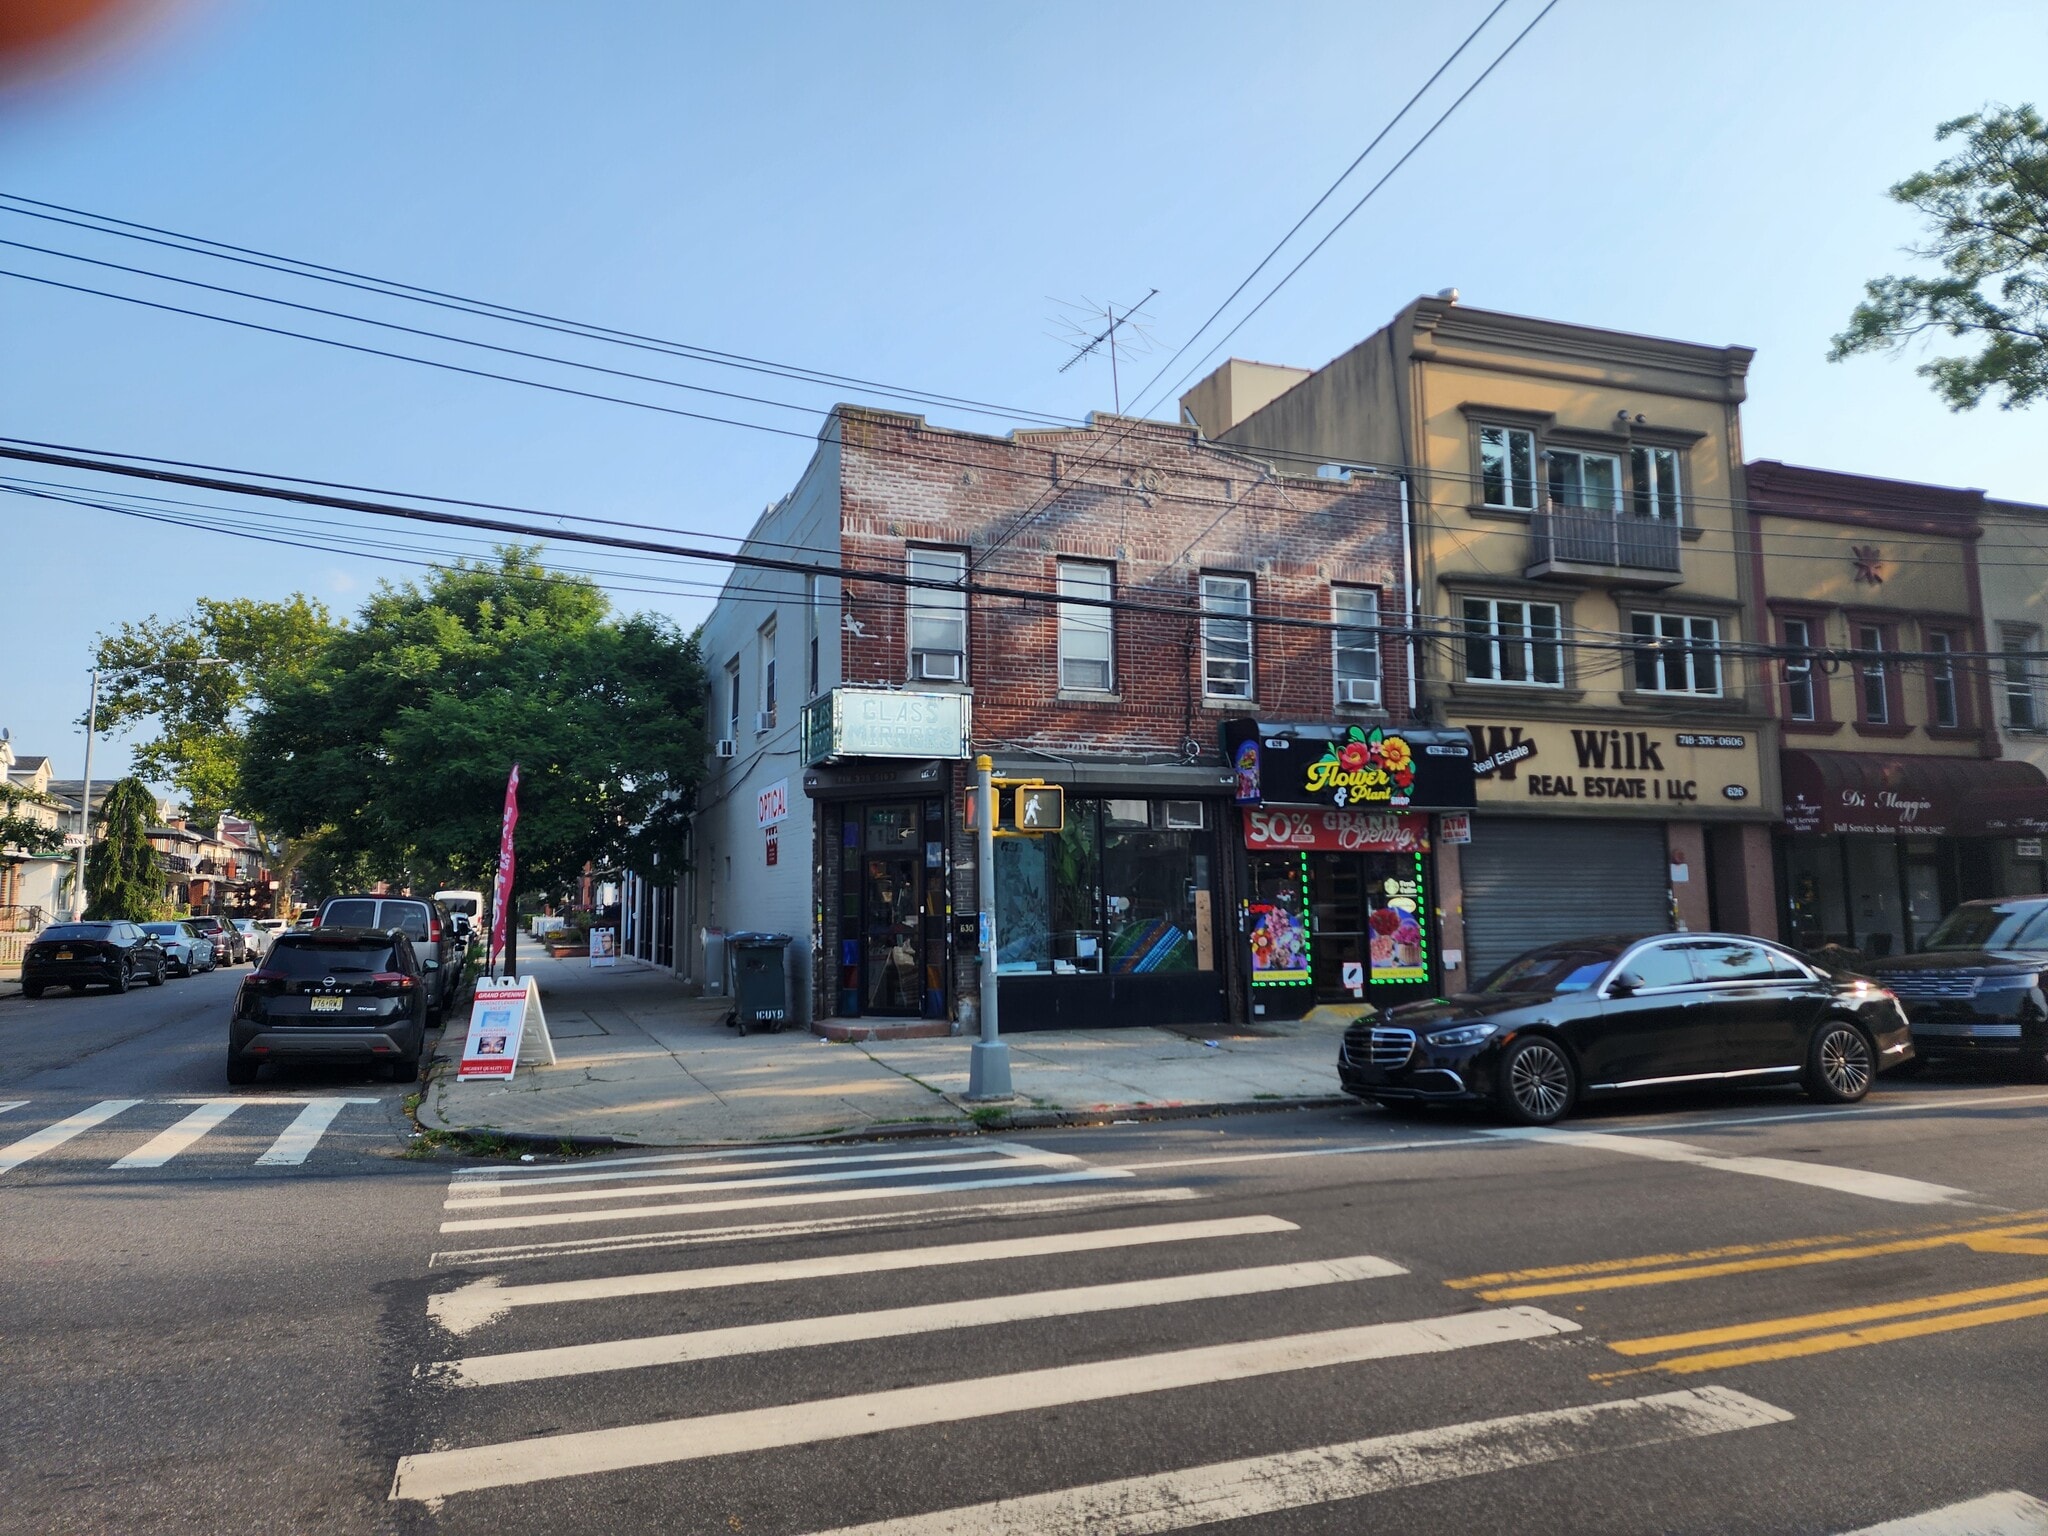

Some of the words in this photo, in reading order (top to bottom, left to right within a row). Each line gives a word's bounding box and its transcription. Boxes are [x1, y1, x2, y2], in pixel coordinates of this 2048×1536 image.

[863, 699, 939, 723] GLASS
[849, 724, 955, 750] MIRRORS
[1495, 745, 1529, 765] Estate
[1571, 729, 1665, 771] Wilk
[1305, 761, 1390, 791] Flower
[1528, 775, 1577, 796] REAL
[1584, 777, 1647, 798] ESTATE
[1667, 779, 1697, 800] LLC
[1333, 787, 1347, 807] &
[1349, 785, 1391, 803] Plant
[1727, 786, 1744, 797] 626
[1842, 788, 1866, 807] Di
[758, 786, 785, 823] OPTICAL
[1250, 812, 1312, 843] 50%
[1322, 811, 1401, 830] GRAND
[1444, 816, 1467, 830] ATM
[1338, 823, 1414, 849] Opening
[960, 924, 974, 933] 630
